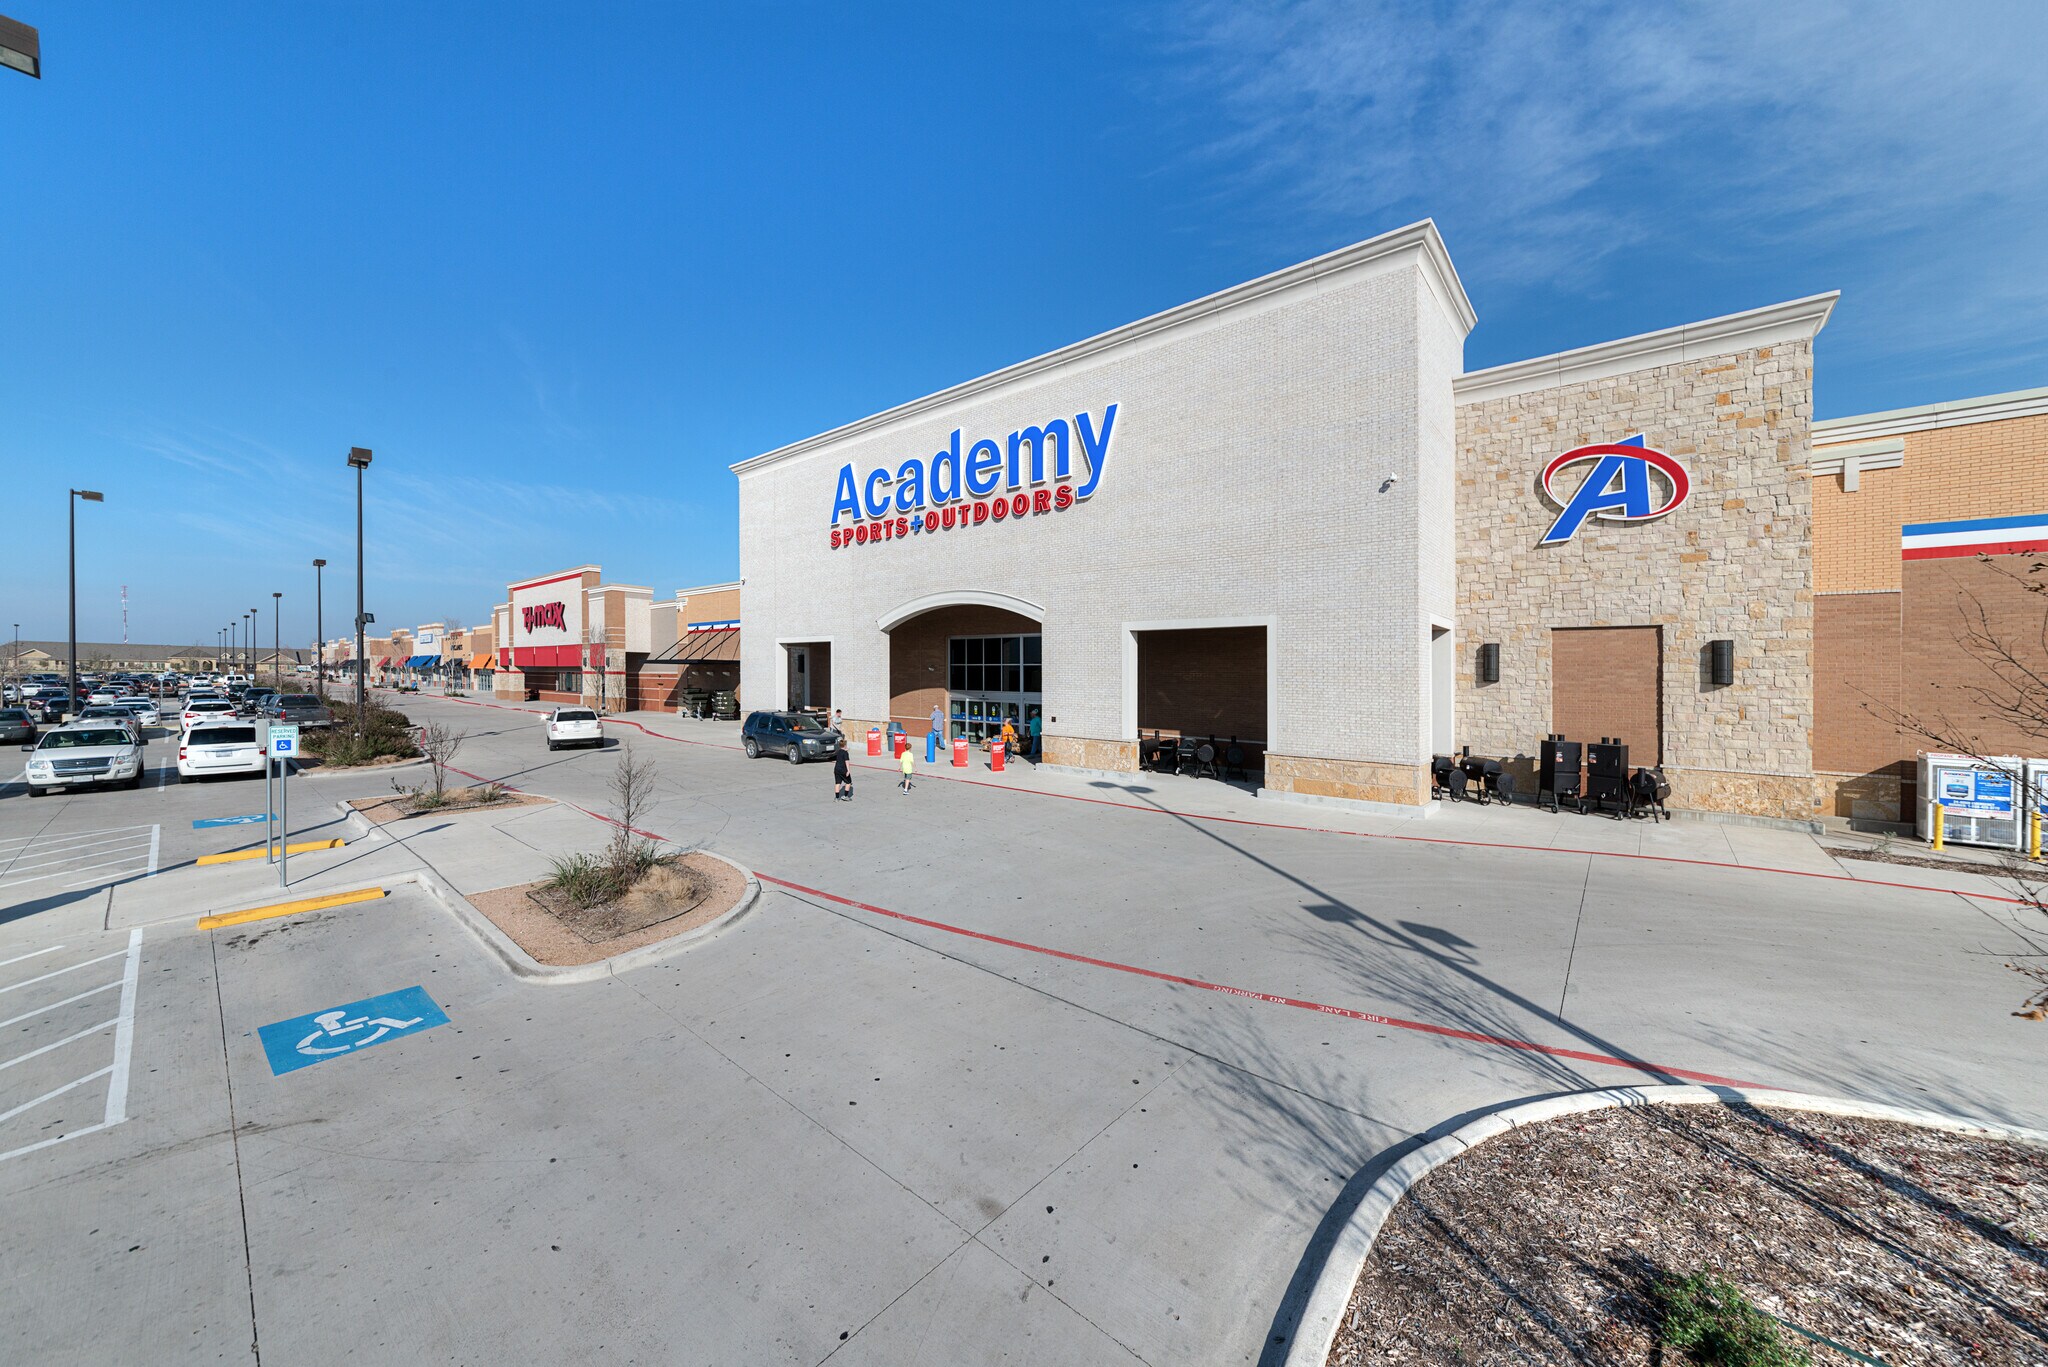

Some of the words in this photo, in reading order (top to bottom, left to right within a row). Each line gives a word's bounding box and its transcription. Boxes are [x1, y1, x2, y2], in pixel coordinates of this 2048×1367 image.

[830, 403, 1120, 526] Academy
[1541, 432, 1652, 544] A
[1214, 985, 1263, 1000] PARKING
[1318, 1005, 1350, 1016] LANE
[1359, 1012, 1388, 1023] FIRE
